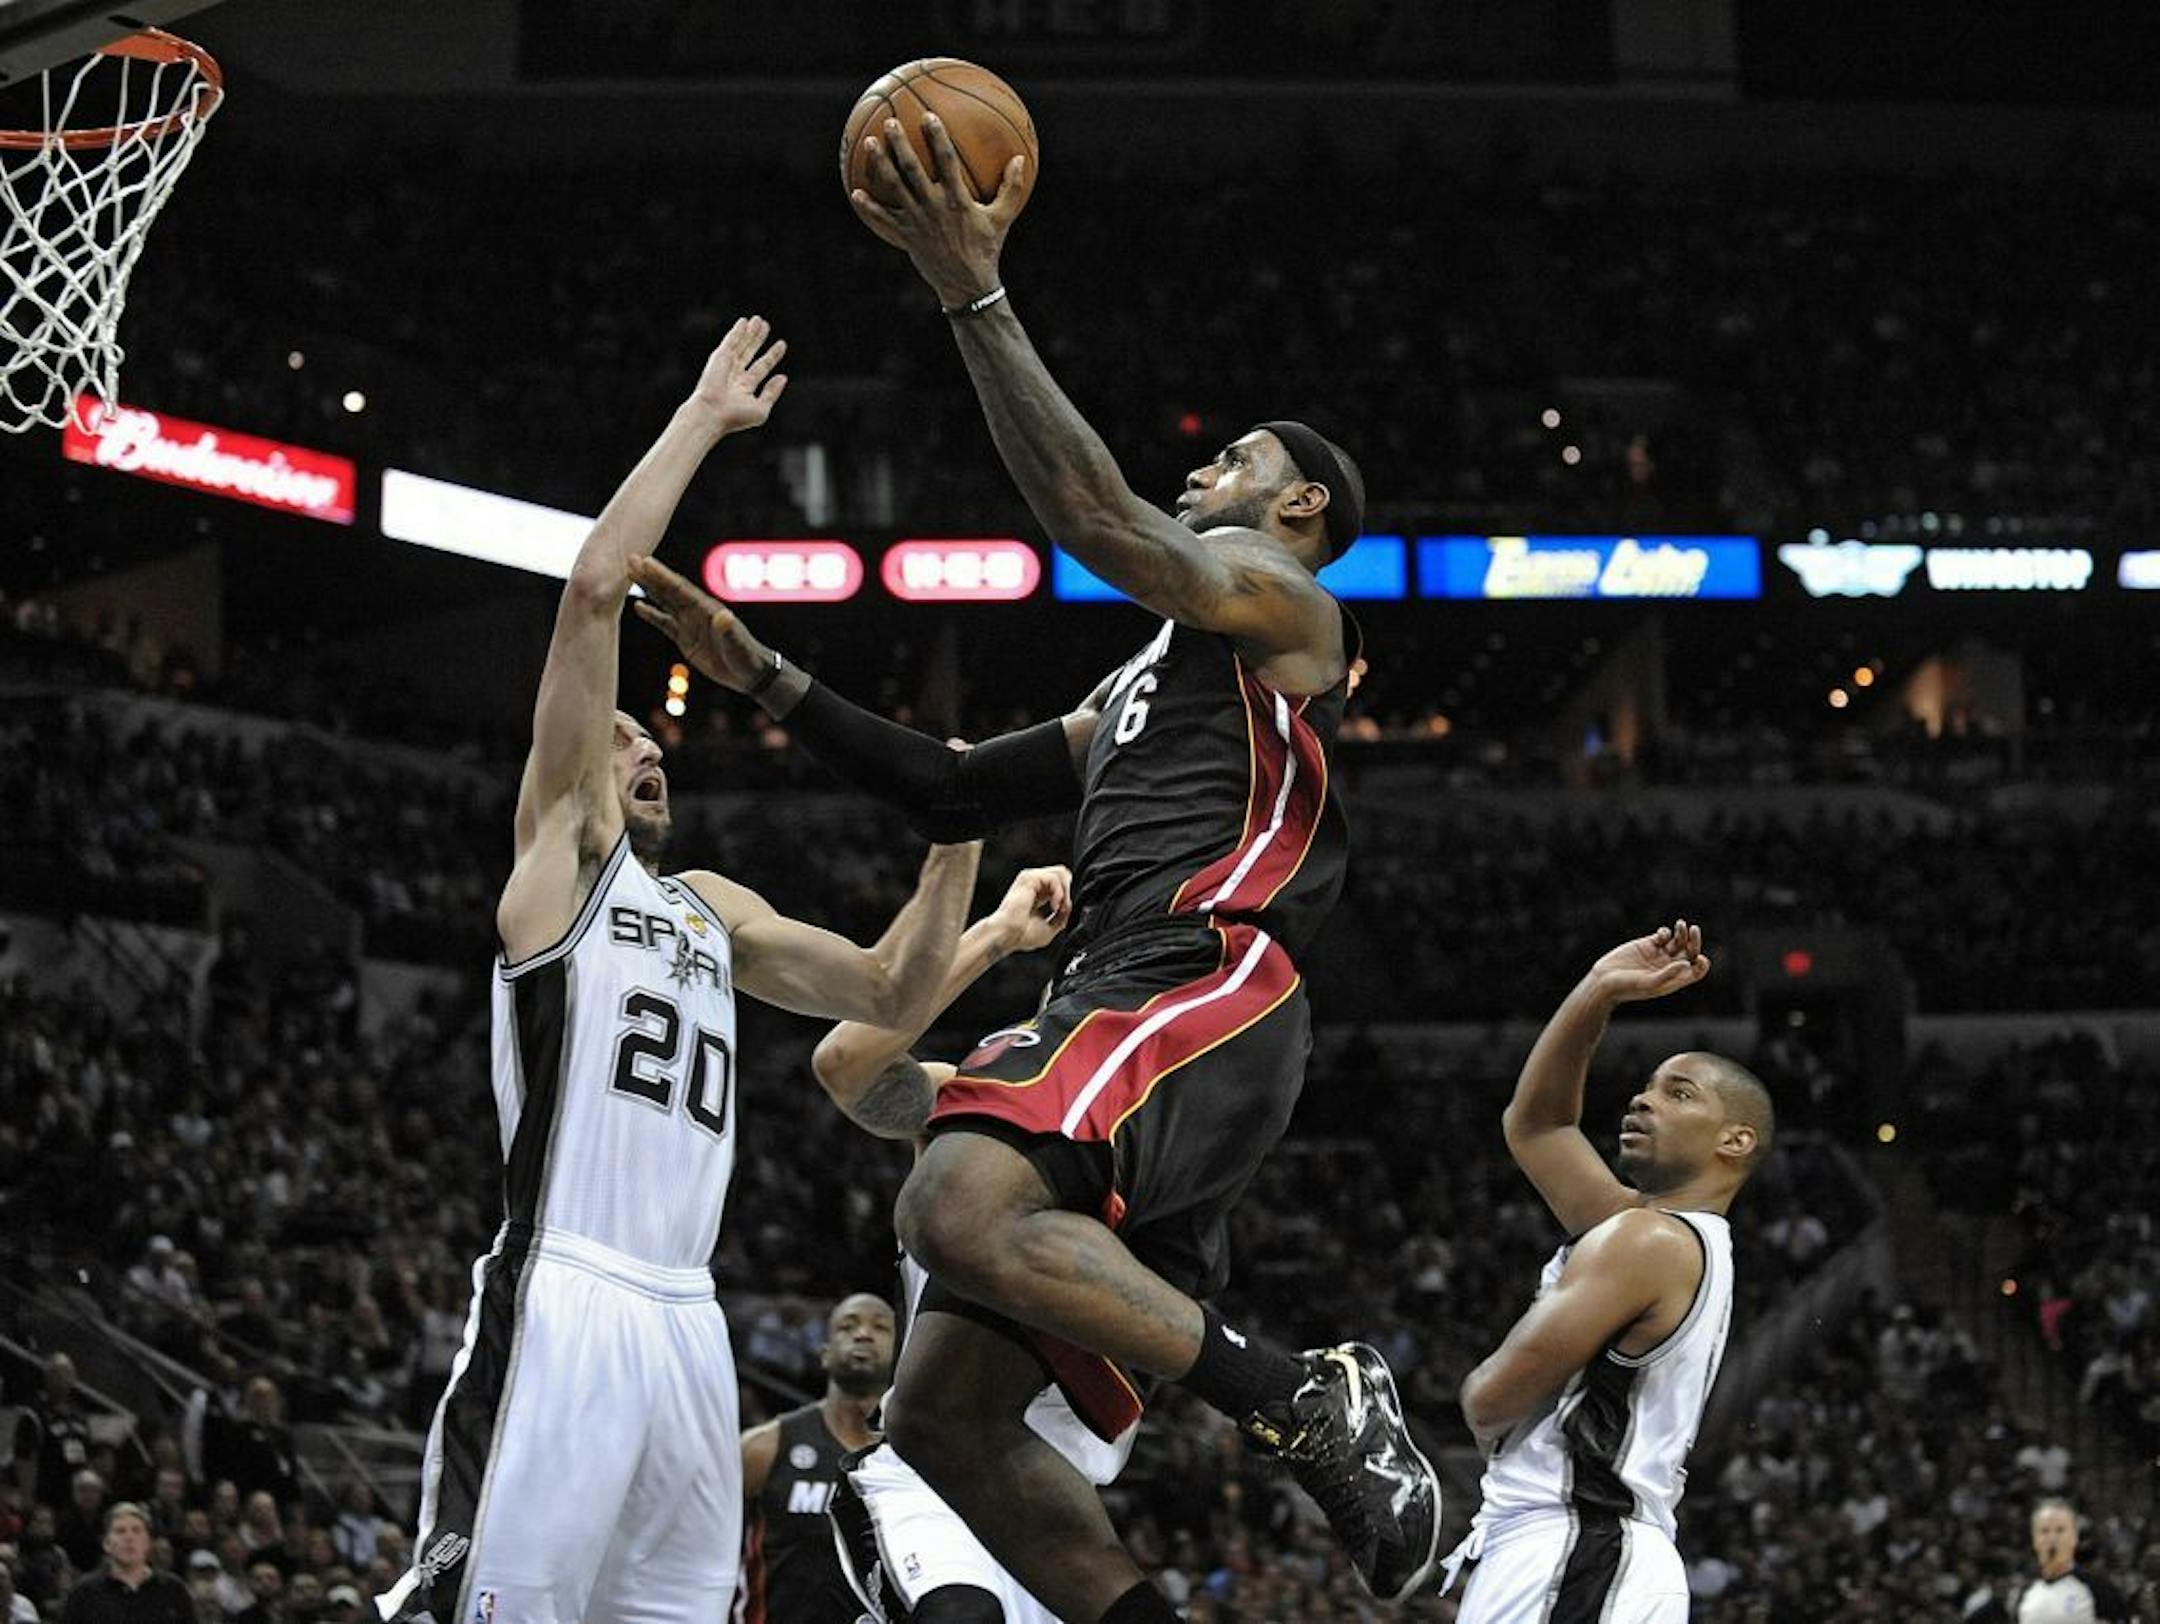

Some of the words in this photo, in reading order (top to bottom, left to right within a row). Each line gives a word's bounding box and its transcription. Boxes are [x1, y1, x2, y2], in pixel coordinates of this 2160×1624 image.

[1114, 672, 1158, 746] 6
[609, 905, 730, 994] SPUR
[609, 986, 730, 1142] 20
